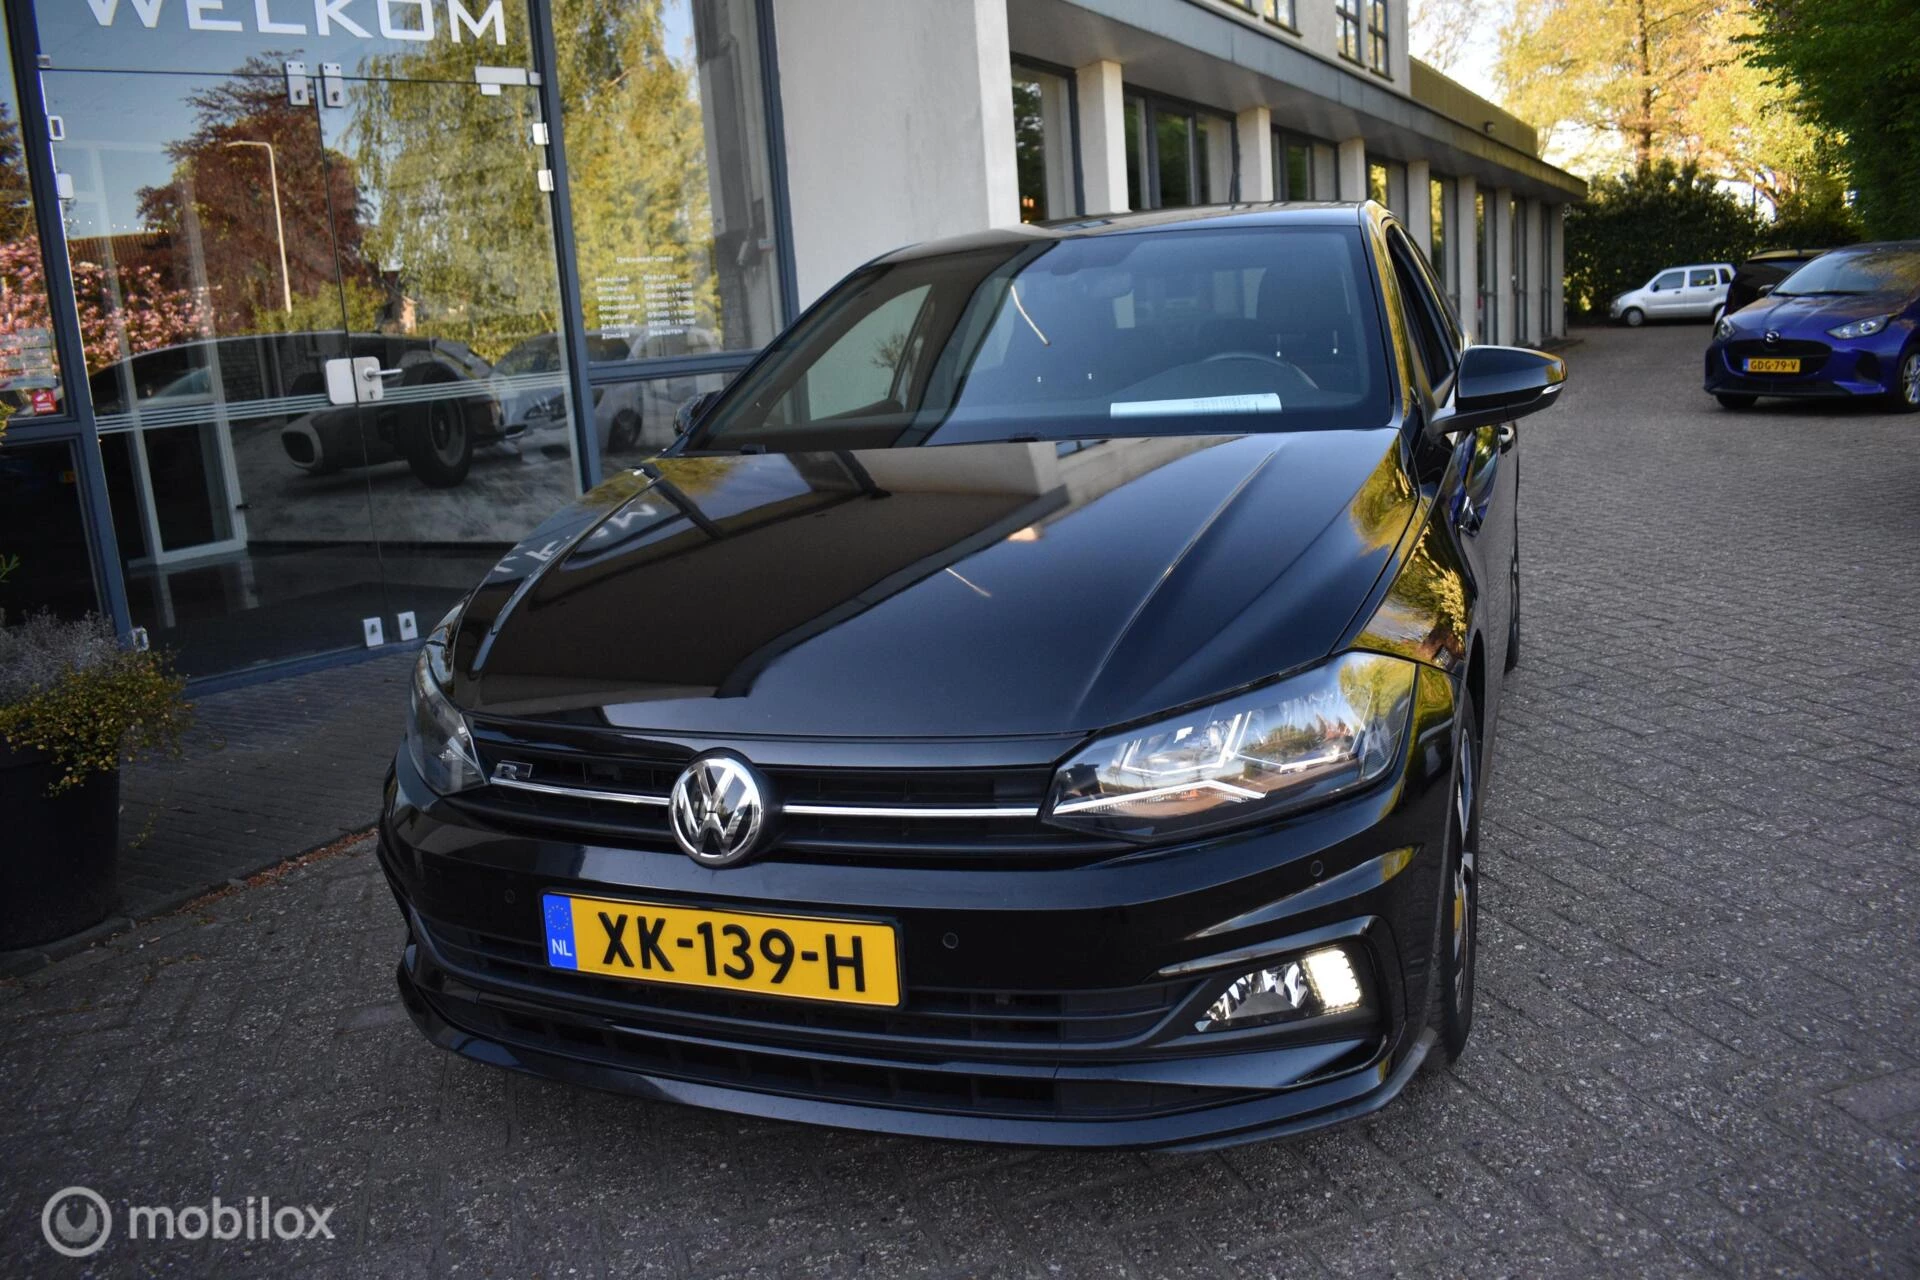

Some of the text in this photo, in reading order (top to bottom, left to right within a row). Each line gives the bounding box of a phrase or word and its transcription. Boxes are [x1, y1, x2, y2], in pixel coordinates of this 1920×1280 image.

[85, 0, 507, 46] WELKOM
[1750, 360, 1798, 370] GDG-79-V
[552, 938, 573, 958] NL
[598, 911, 867, 993] XK-139-H
